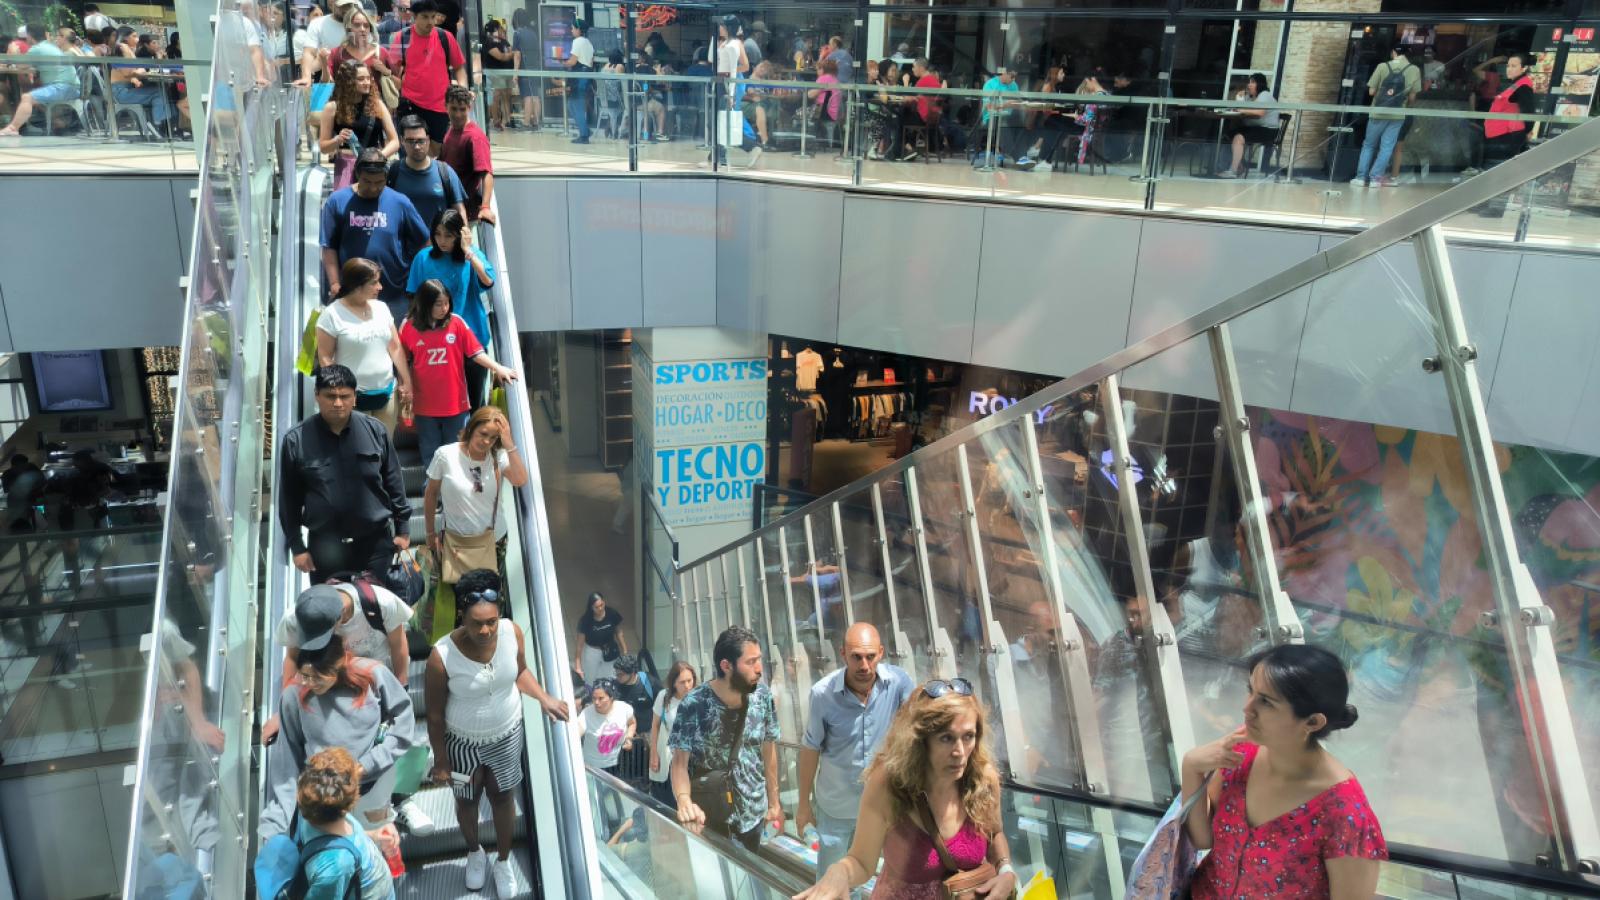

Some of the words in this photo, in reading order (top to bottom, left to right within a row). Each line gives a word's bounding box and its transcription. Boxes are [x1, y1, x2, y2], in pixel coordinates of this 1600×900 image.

[427, 348, 448, 365] 22
[656, 360, 766, 385] SPORTS
[655, 403, 714, 428] HOGAR
[724, 400, 766, 422] DECO
[968, 391, 1054, 424] ROY
[656, 443, 764, 484] TECNO
[657, 486, 670, 507] Y
